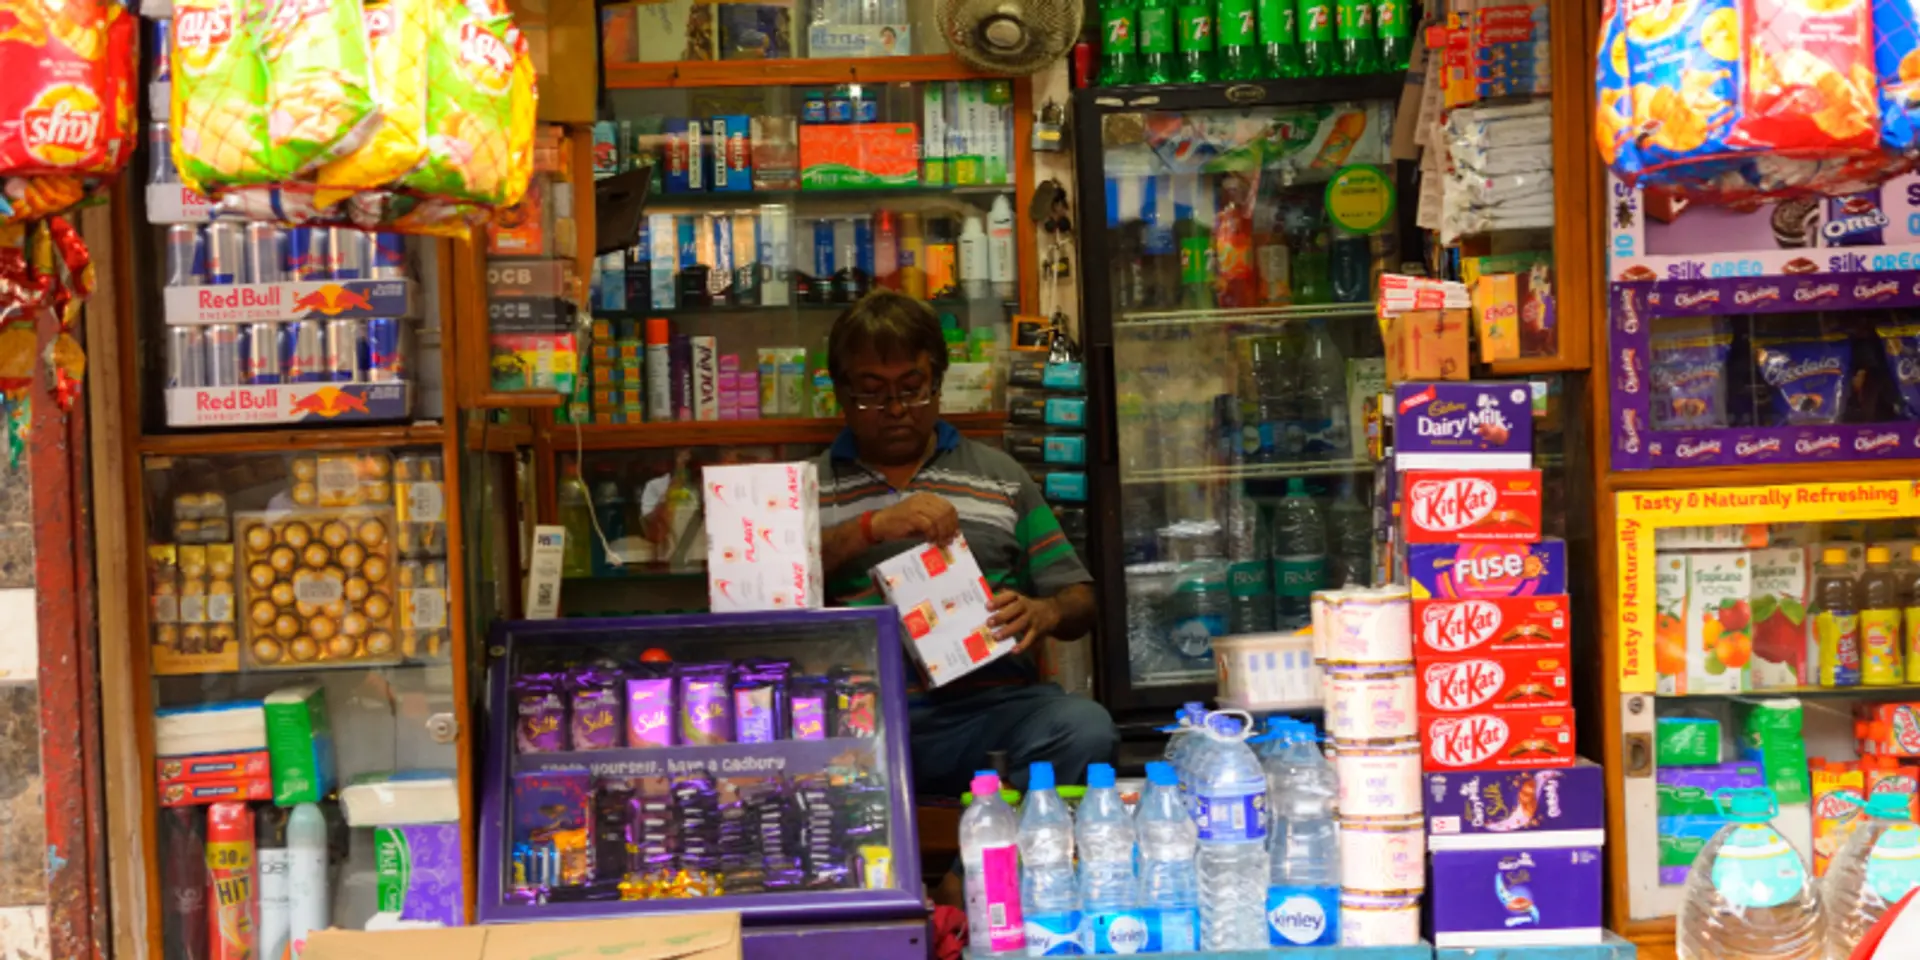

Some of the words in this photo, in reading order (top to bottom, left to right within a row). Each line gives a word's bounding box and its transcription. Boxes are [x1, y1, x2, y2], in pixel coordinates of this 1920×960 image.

[1824, 214, 1889, 237] OREO
[487, 269, 532, 284] OCB
[199, 289, 239, 308] Red
[242, 287, 280, 306] Bull
[1485, 301, 1517, 322] ENO
[196, 391, 237, 410] Red
[239, 389, 278, 409] Bull
[1418, 416, 1468, 438] Dairy
[1468, 408, 1508, 434] Milk
[1427, 481, 1488, 526] KitKat
[1633, 494, 1683, 514] Tasty
[1687, 492, 1700, 508] &
[1703, 489, 1791, 510] Naturally
[1796, 486, 1899, 505] Refreshing
[1620, 519, 1641, 607] Naturally
[1436, 604, 1492, 647] KitKat
[1622, 627, 1643, 679] Tasty
[1440, 663, 1496, 707] KitKat
[634, 710, 668, 734] Silk
[1444, 719, 1499, 762] KitKat
[708, 761, 718, 773] a
[216, 876, 249, 906] HIT
[1273, 908, 1325, 934] kinley
